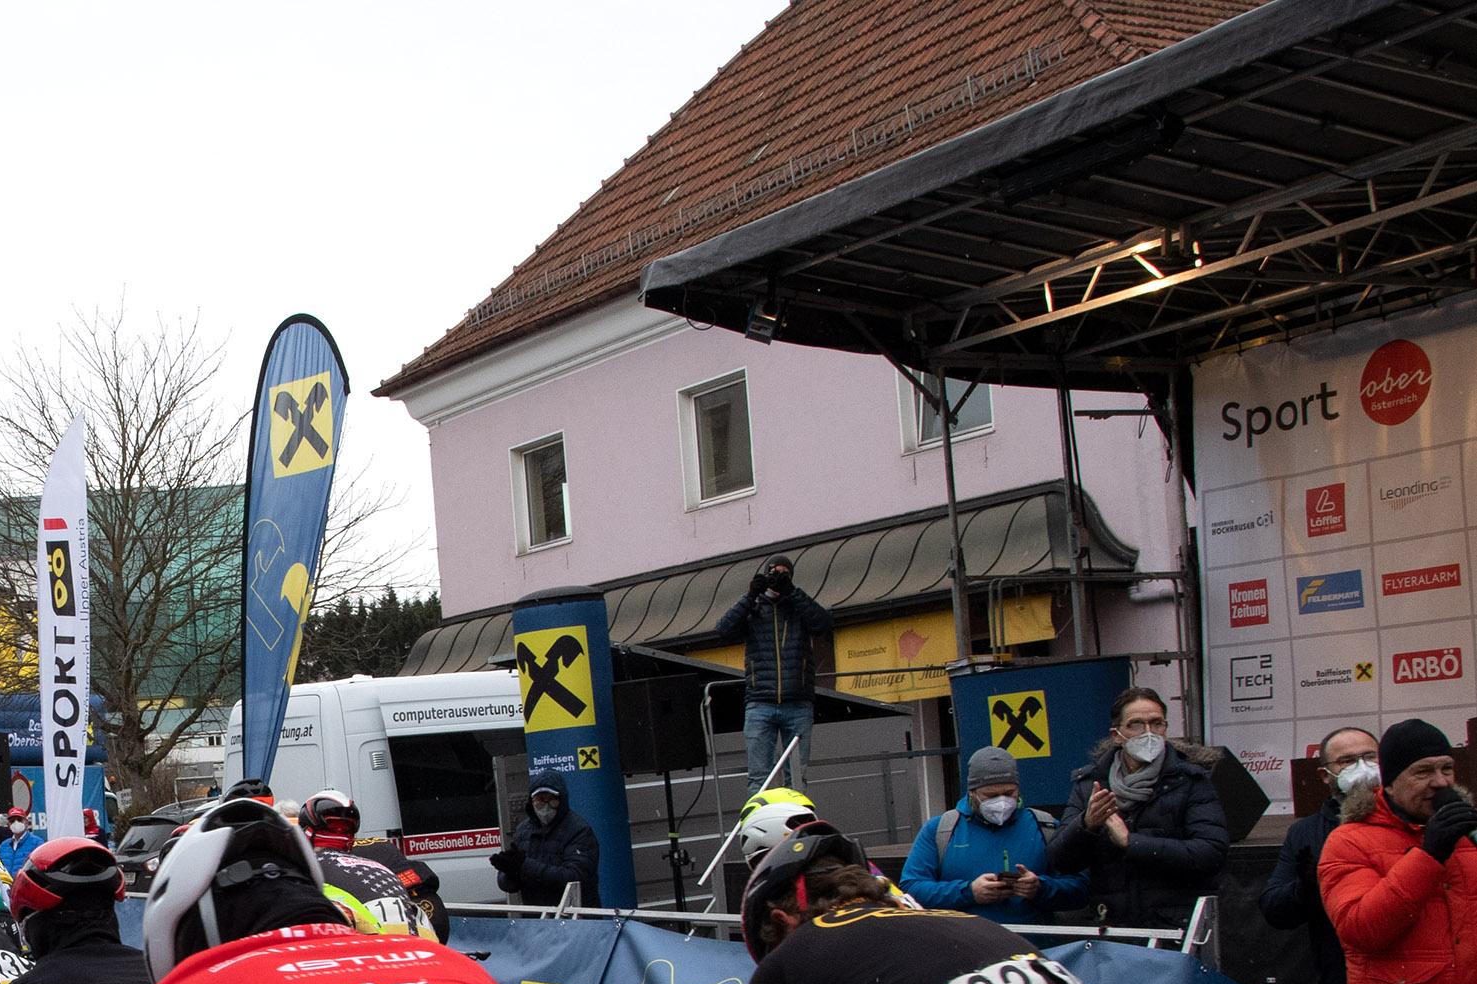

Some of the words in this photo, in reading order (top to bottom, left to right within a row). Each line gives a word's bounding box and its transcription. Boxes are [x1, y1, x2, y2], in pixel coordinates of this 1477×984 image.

[1360, 367, 1432, 398] ober
[1371, 393, 1418, 412] österreich
[1221, 382, 1340, 448] Sport
[1380, 480, 1438, 501] Leonding
[1310, 515, 1343, 528] Löffler
[1385, 571, 1458, 590] FLYERALARM
[1230, 587, 1266, 604] Kronen
[1230, 602, 1267, 619] Zeitung
[1316, 668, 1352, 678] Raiffeisen
[1396, 648, 1459, 681] ARBÖ
[1235, 674, 1273, 688] TECH
[1300, 676, 1352, 688] Oberösterreich
[393, 702, 524, 724] computerauswertung.a
[533, 754, 575, 766] Raiffeisen
[409, 835, 474, 853] Professionelle
